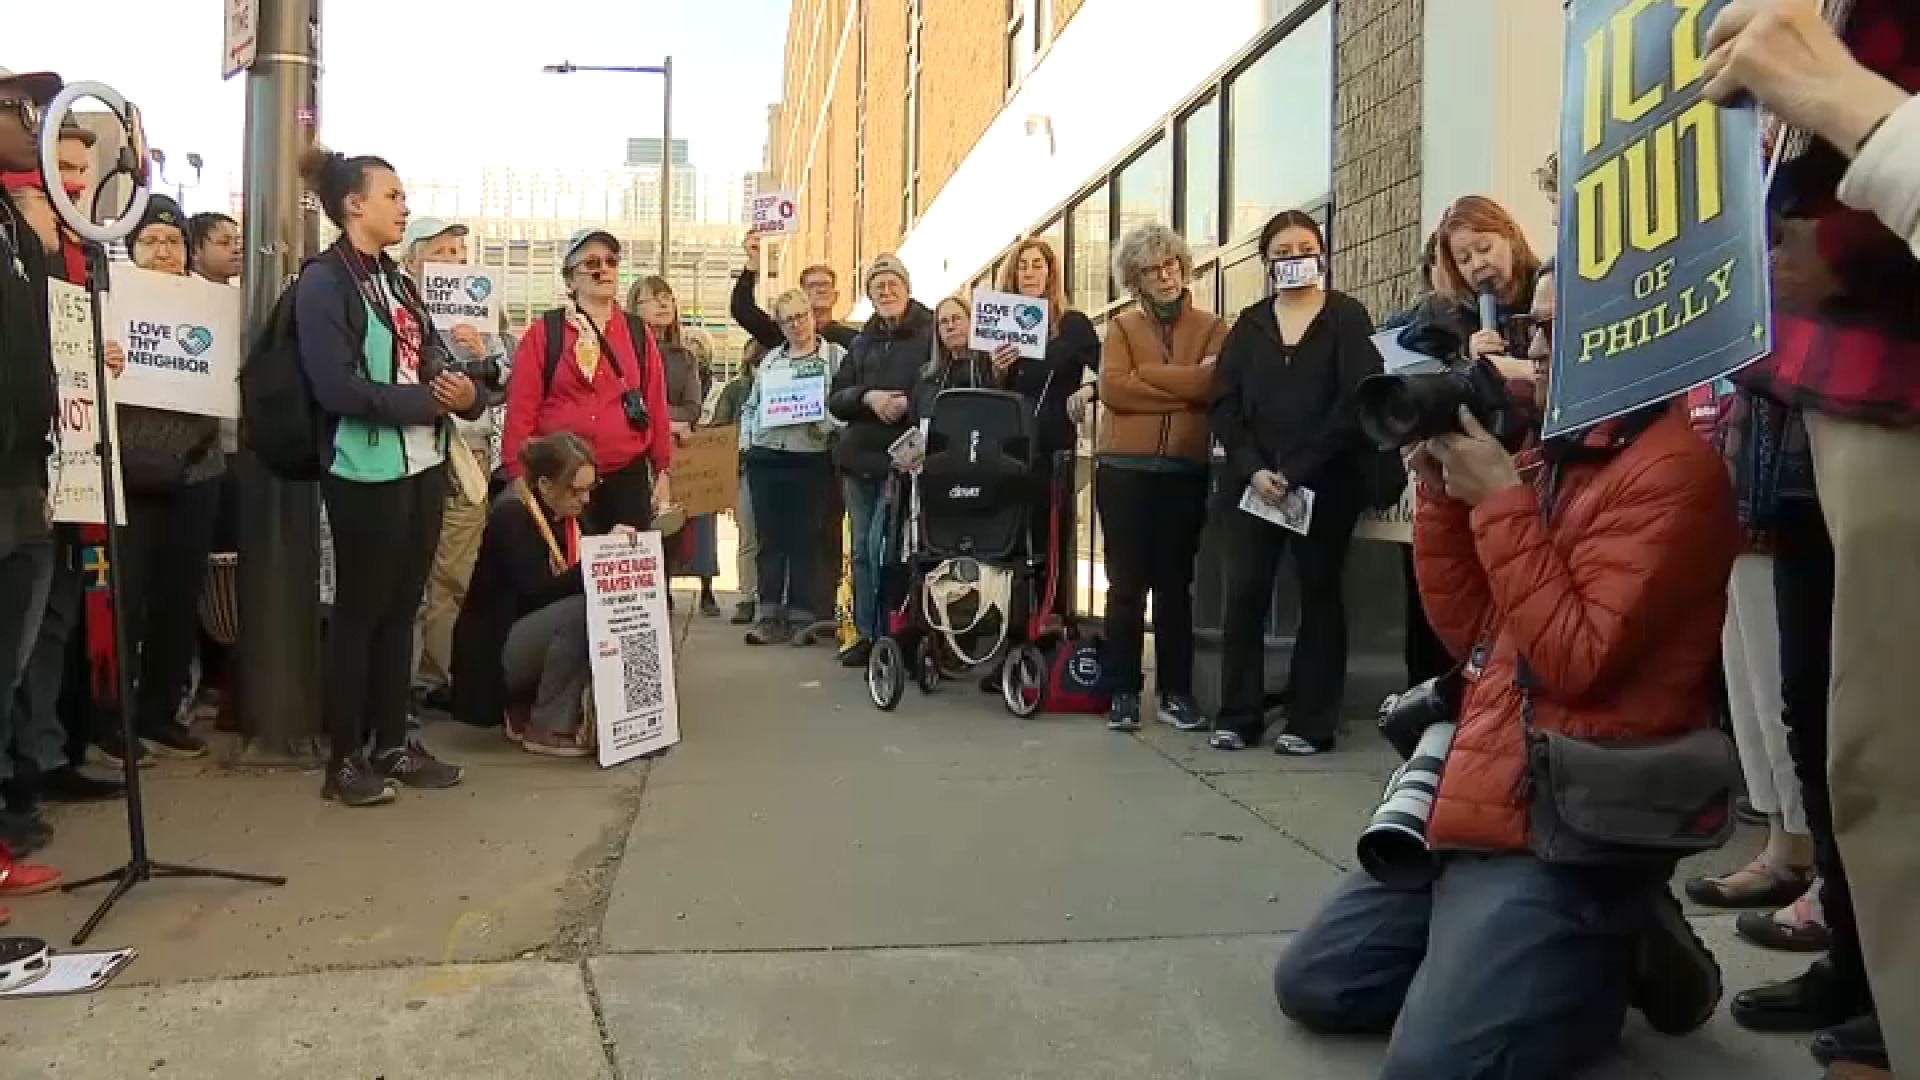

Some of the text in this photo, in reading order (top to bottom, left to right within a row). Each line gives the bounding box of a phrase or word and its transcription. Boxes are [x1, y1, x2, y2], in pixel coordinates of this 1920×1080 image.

[1574, 100, 1724, 281] OUT
[426, 276, 460, 290] LOVE
[1632, 258, 1676, 300] OF
[426, 289, 453, 301] THY
[976, 302, 1010, 317] LOVE
[1578, 258, 1738, 363] PHILLY
[127, 319, 171, 340] LOVE
[976, 315, 1001, 326] THY
[127, 335, 160, 351] THY
[975, 327, 1038, 346] NEIGHBOR
[127, 350, 210, 375] NEIGHBOR
